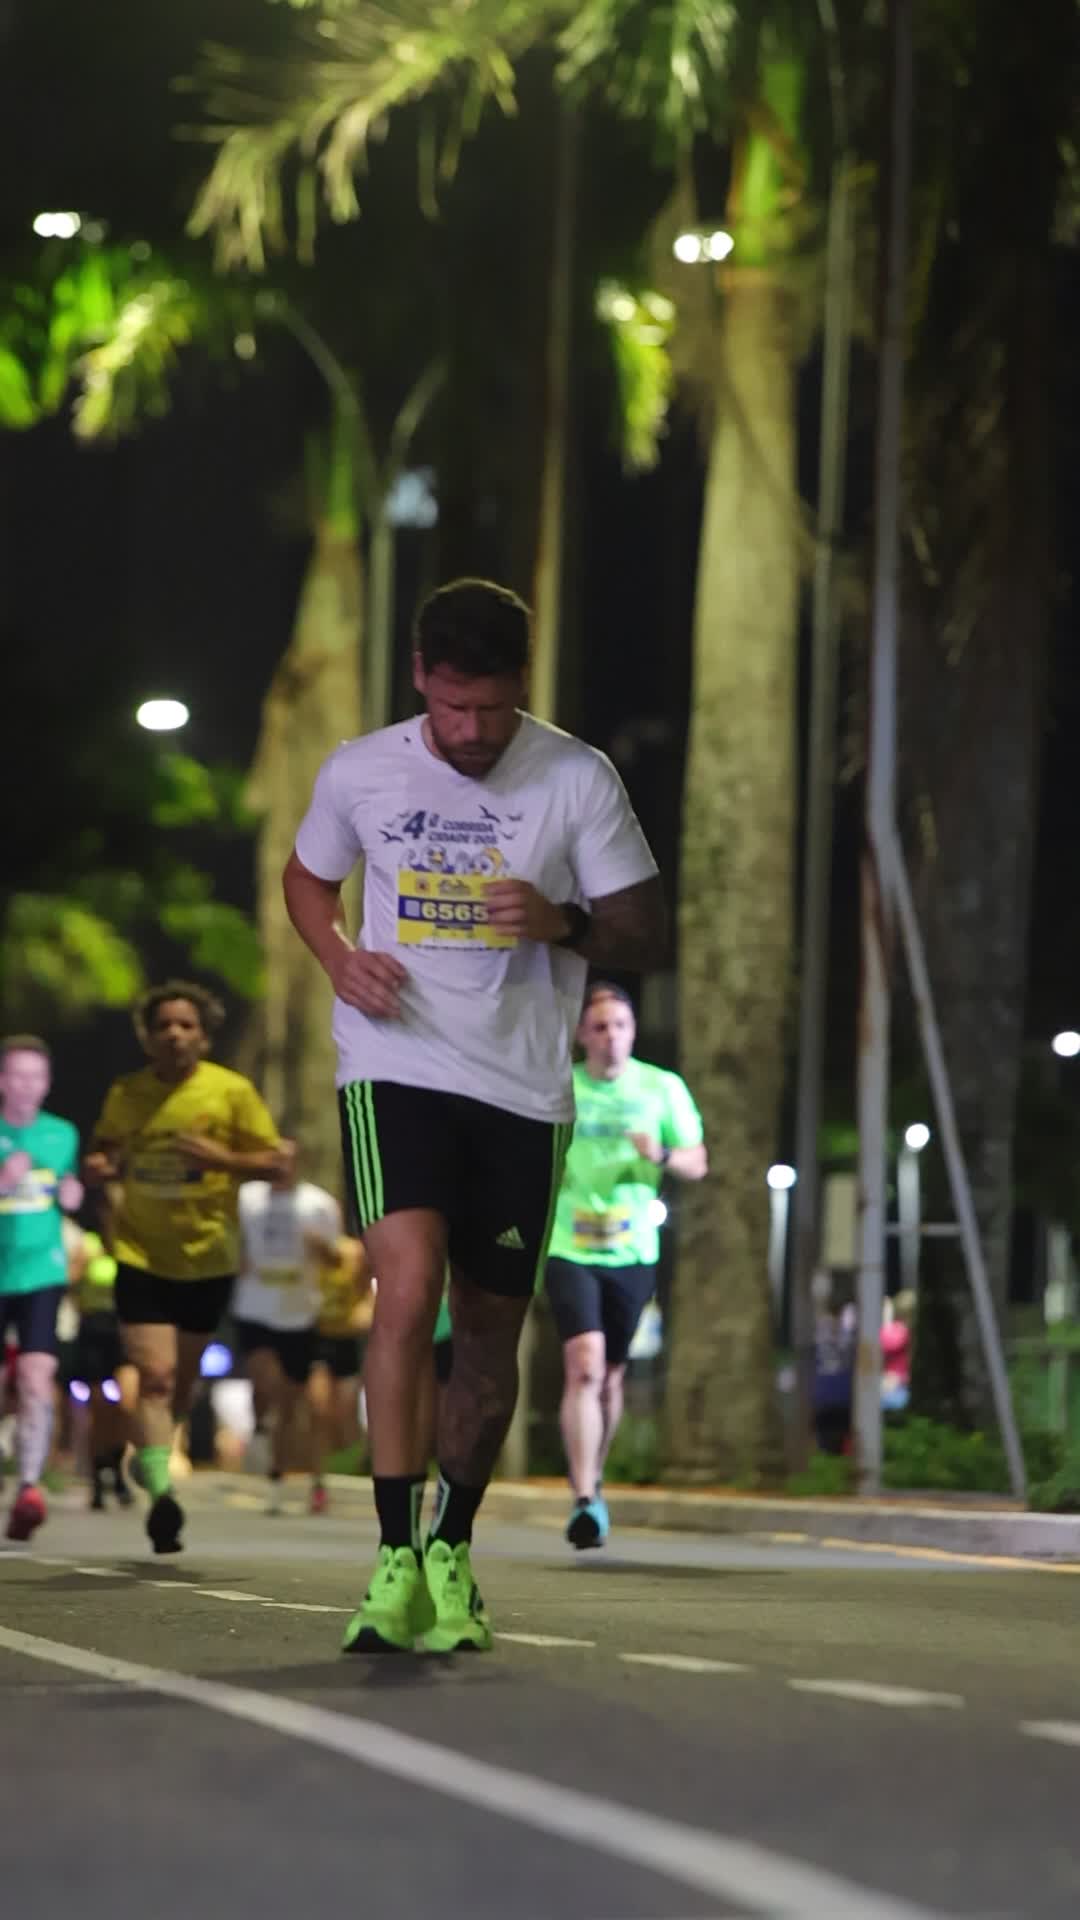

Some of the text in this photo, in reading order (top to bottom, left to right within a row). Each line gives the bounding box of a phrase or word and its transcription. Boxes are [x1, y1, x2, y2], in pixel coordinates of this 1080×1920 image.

[443, 821, 494, 832] CORRIDA
[428, 832, 470, 844] CIDADE
[421, 901, 488, 921] 6565
